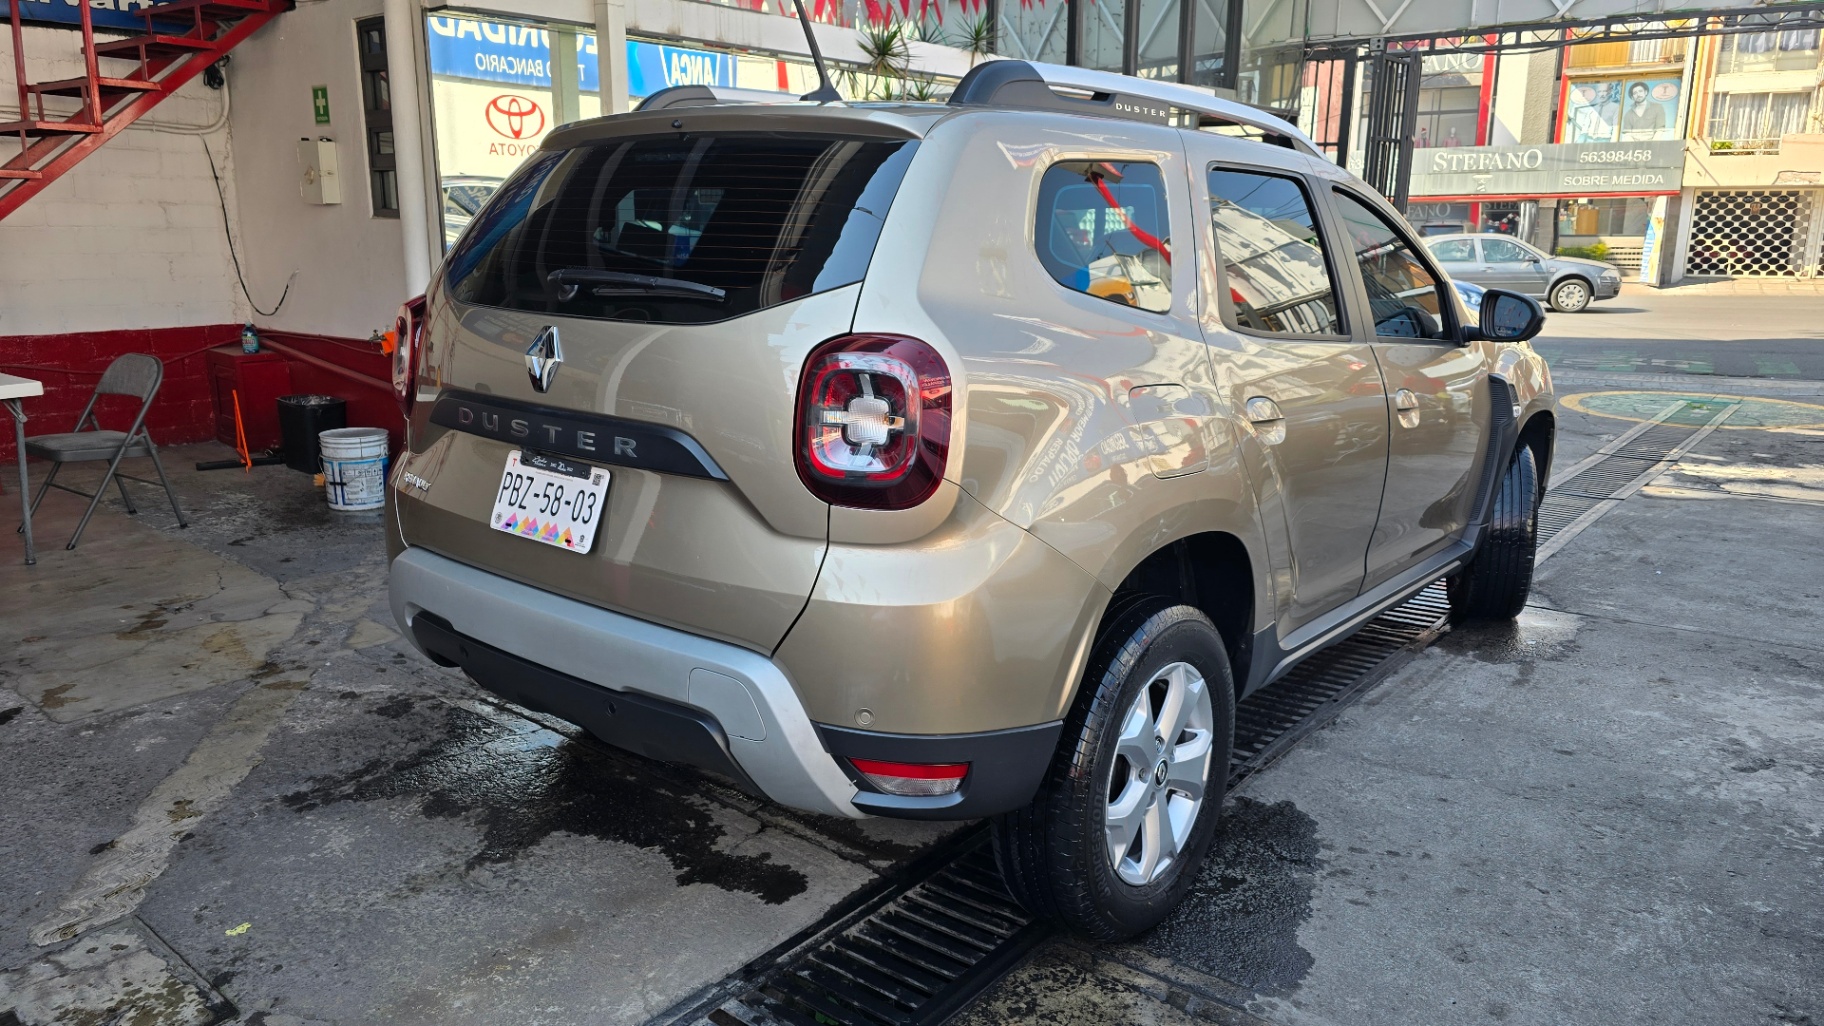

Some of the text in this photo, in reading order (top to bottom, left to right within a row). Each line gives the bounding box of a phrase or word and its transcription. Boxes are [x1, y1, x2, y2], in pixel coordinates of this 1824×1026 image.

[1115, 102, 1167, 117] DUSTER
[1433, 148, 1542, 172] STEFANO
[1579, 149, 1652, 164] 56398458
[1563, 173, 1665, 186] SOBRE MEDIDA
[458, 406, 639, 458] DUSTER
[498, 471, 597, 525] PBZ-58-03
